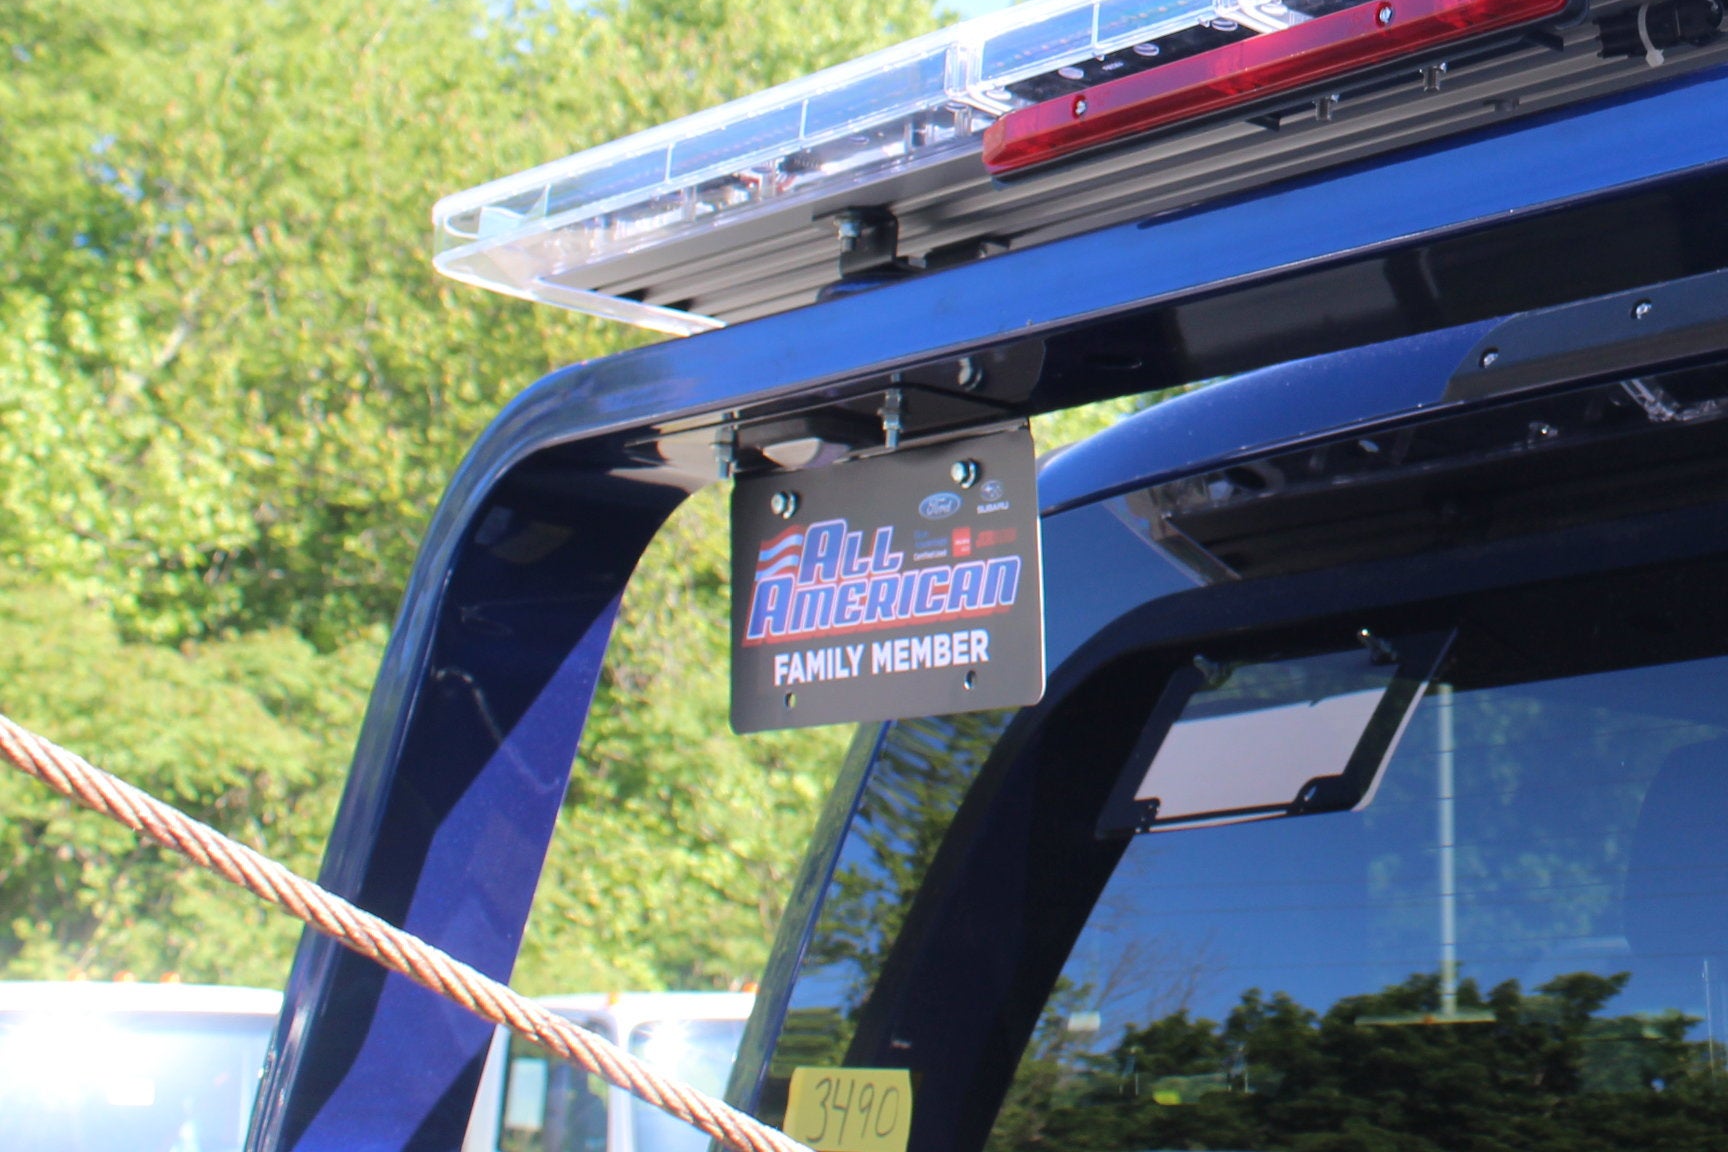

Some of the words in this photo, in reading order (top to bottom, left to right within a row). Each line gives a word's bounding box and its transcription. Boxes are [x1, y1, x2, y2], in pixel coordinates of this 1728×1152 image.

[797, 518, 904, 585] ALL
[746, 555, 1022, 641] AMERICAN
[773, 643, 865, 687] FAMILY
[871, 628, 990, 675] MEMBER
[805, 1077, 901, 1146] 3490
